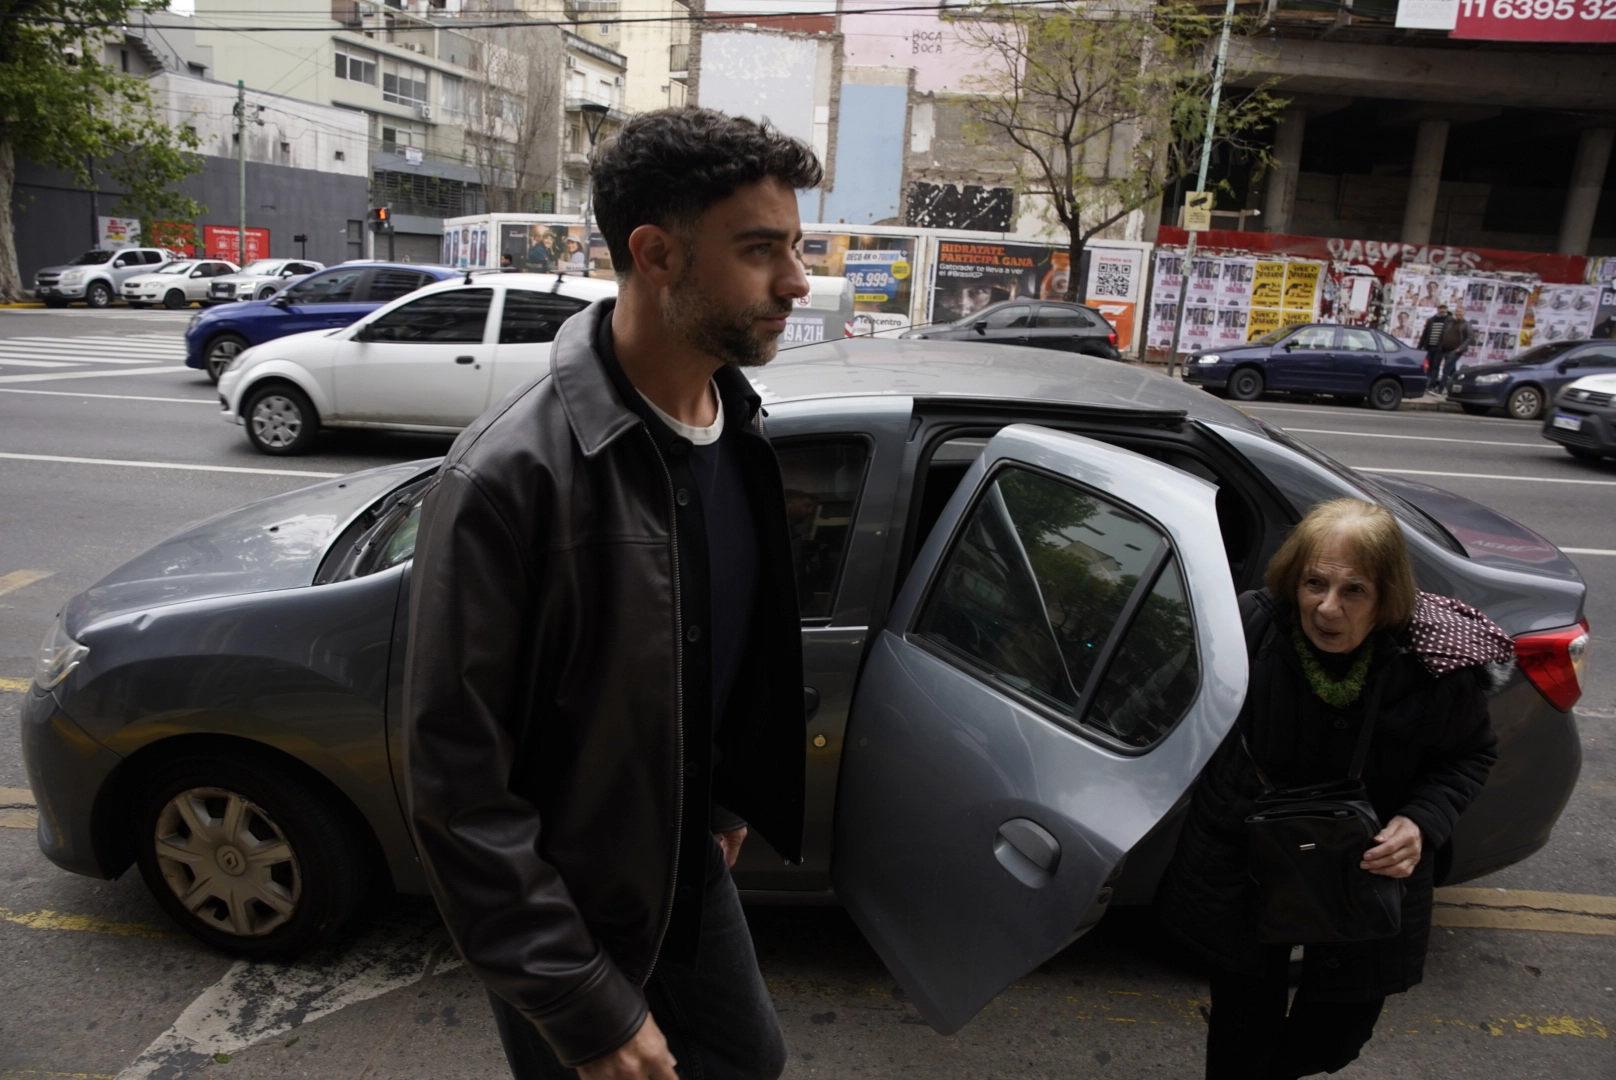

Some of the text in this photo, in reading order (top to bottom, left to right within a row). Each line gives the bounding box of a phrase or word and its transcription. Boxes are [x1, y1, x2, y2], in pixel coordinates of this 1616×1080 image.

[1461, 0, 1487, 18] 11
[1492, 0, 1575, 20] 6395
[1580, 0, 1616, 20] 32
[912, 29, 942, 43] BOCA
[912, 42, 942, 54] BOCA
[941, 243, 1004, 255] HIDRATATE
[860, 318, 901, 326] Tecentro
